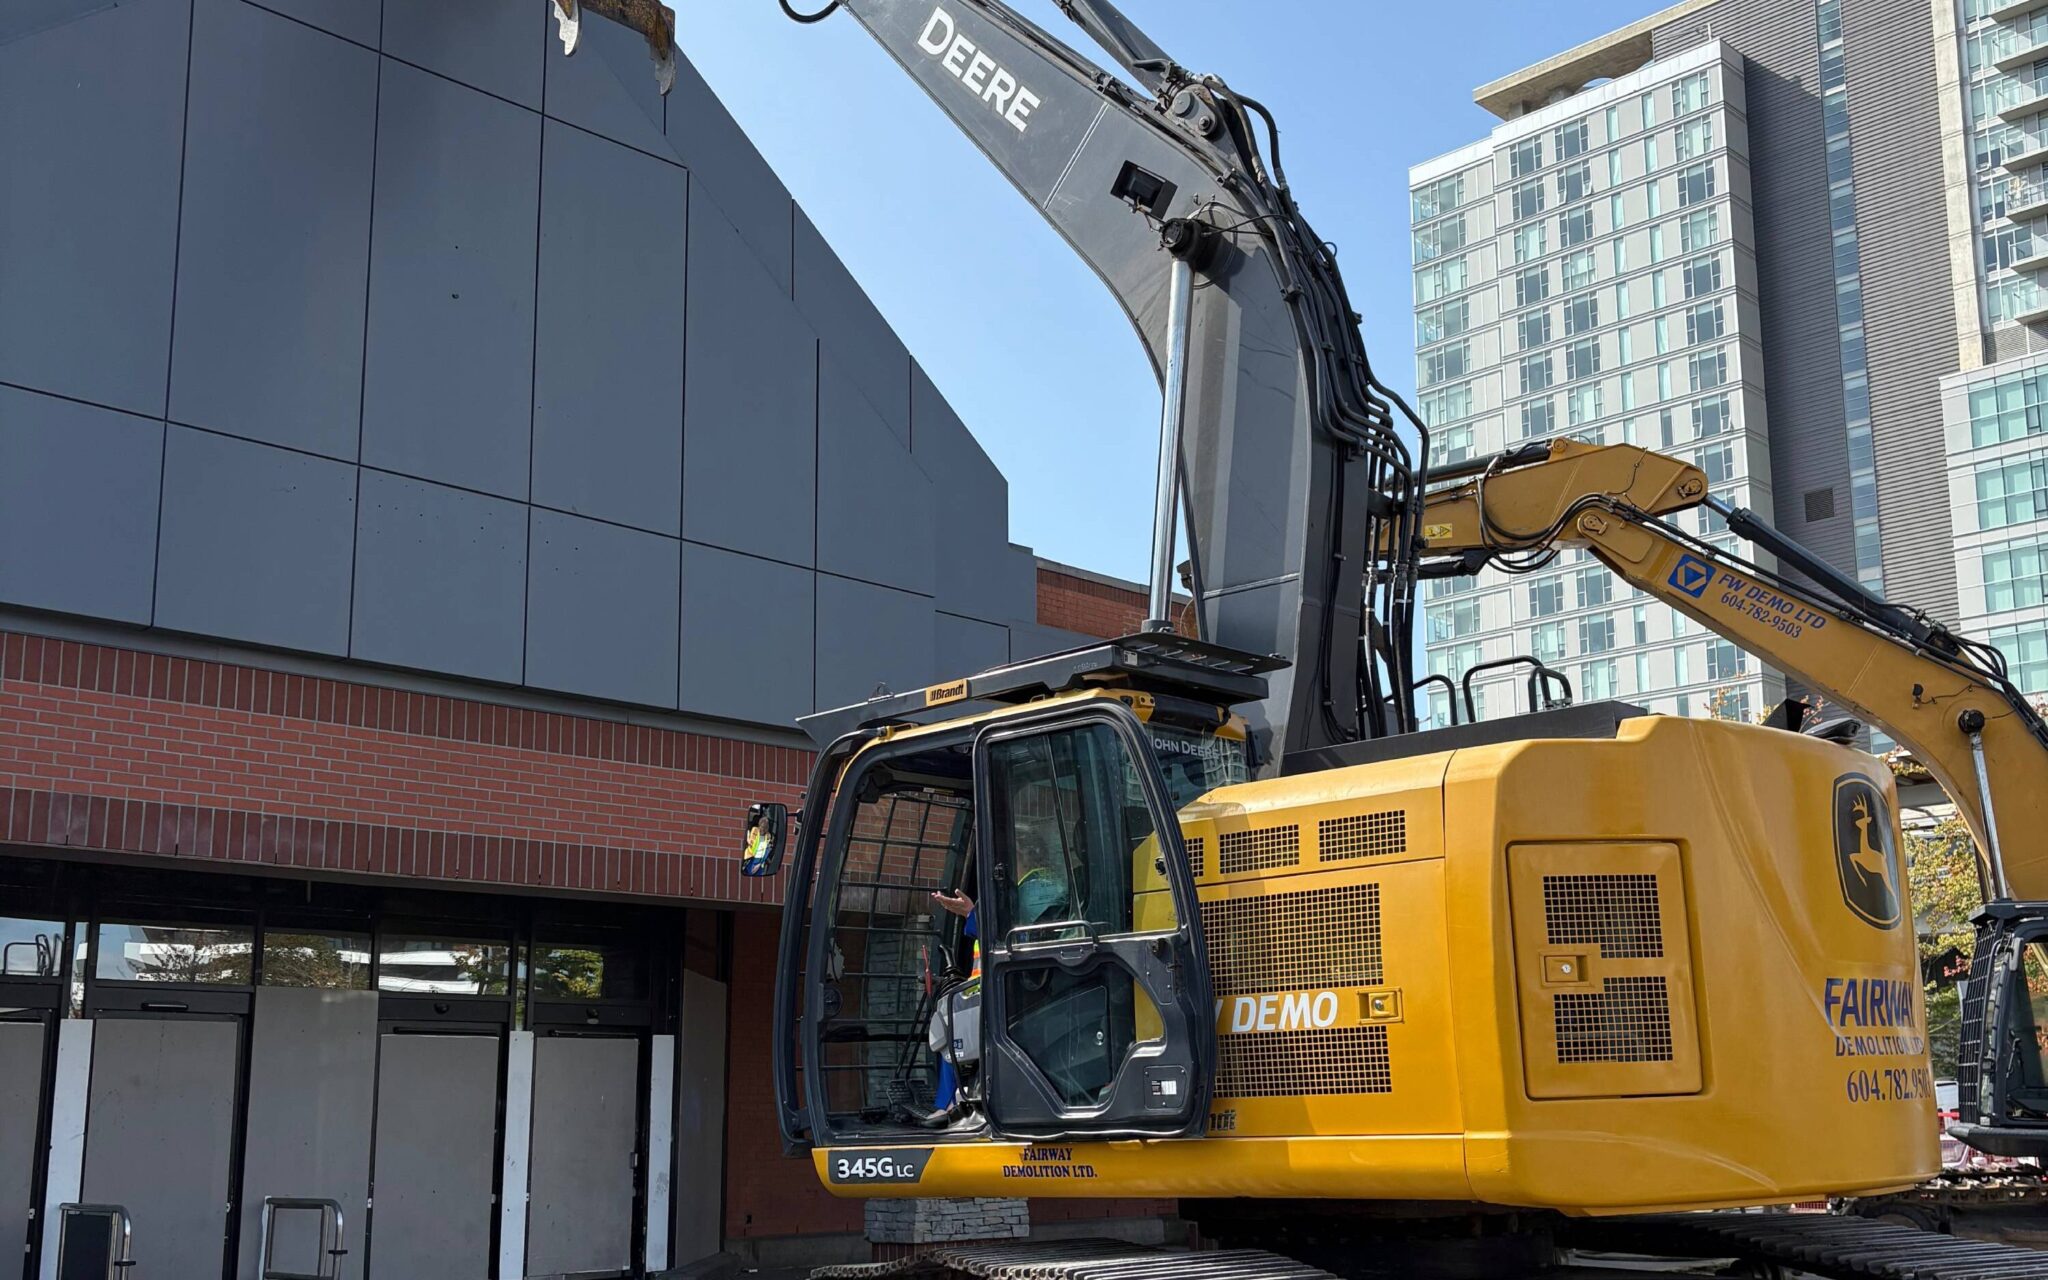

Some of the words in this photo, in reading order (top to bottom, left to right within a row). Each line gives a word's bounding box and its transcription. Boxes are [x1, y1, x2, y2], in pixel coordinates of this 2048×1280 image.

[917, 6, 1041, 132] DEERE
[1718, 573, 1748, 592] FW
[1745, 586, 1794, 615] DEMO
[1794, 608, 1827, 630] LTD
[1721, 592, 1803, 639] 604-782-9503
[936, 684, 964, 700] Brandt
[1181, 740, 1219, 759] DEERE
[1231, 991, 1338, 1033] DEMO
[1824, 978, 1915, 1028] FAIRWAY
[838, 1158, 893, 1178] 345G
[897, 1164, 914, 1178] LC
[1023, 1148, 1073, 1161] FAIRWAY
[1003, 1165, 1072, 1178] DEMOLITION
[1072, 1165, 1098, 1178] LTD.
